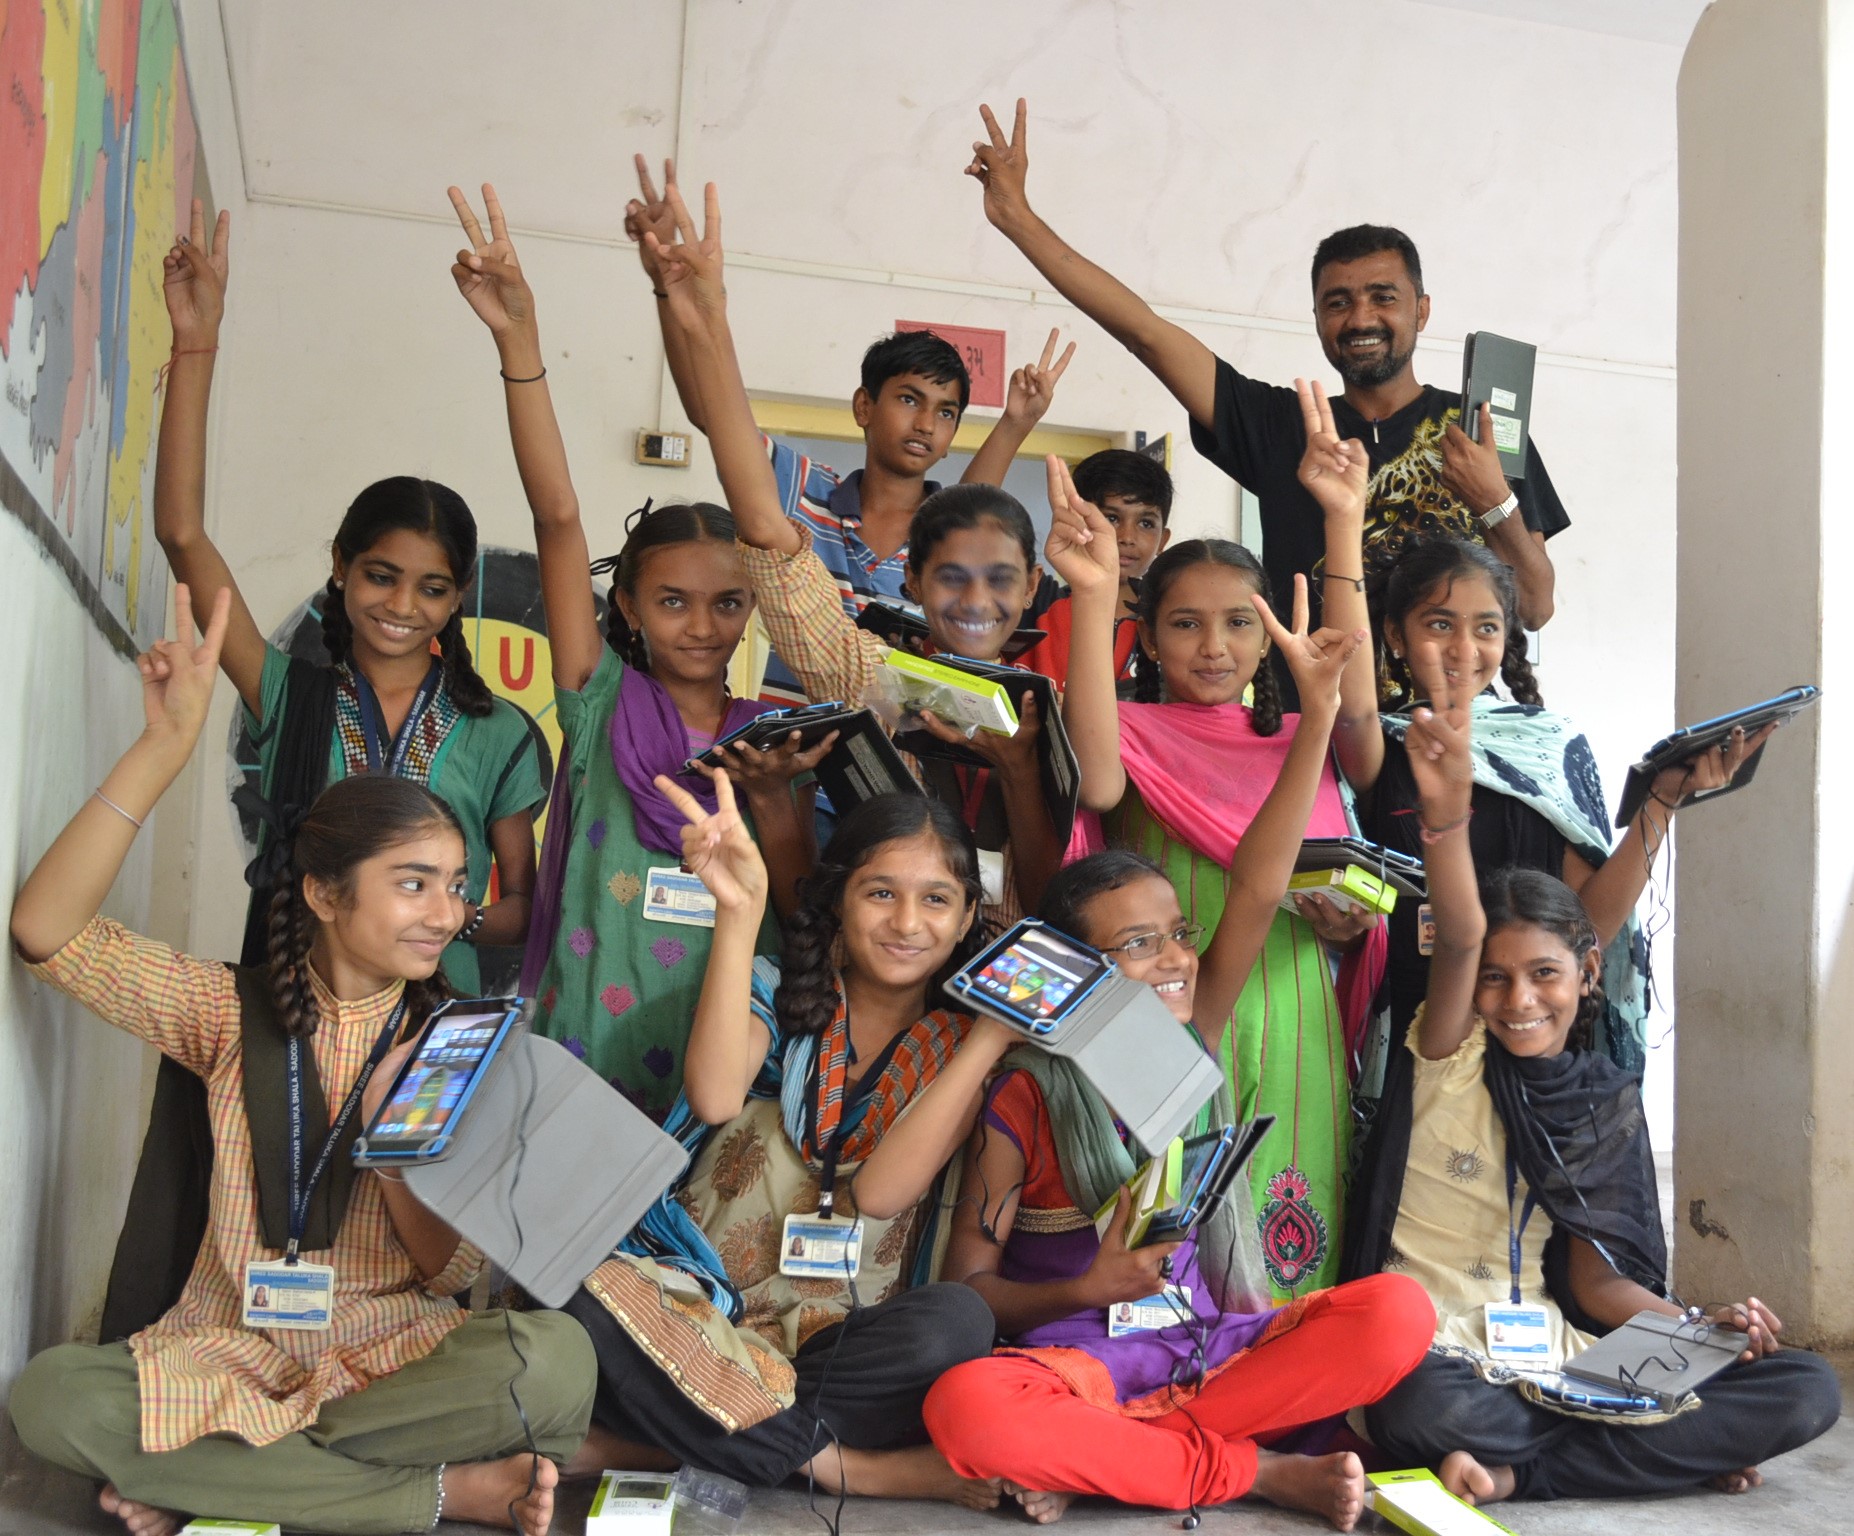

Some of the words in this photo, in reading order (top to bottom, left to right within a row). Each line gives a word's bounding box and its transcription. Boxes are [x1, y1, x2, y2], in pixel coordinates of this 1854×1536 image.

[499, 636, 534, 691] U
[290, 1035, 299, 1072] SADODA
[292, 1076, 300, 1104] SHALA
[357, 1062, 375, 1089] SHREE
[337, 1088, 361, 1127] SADODAR
[322, 1128, 342, 1157] TALUKA
